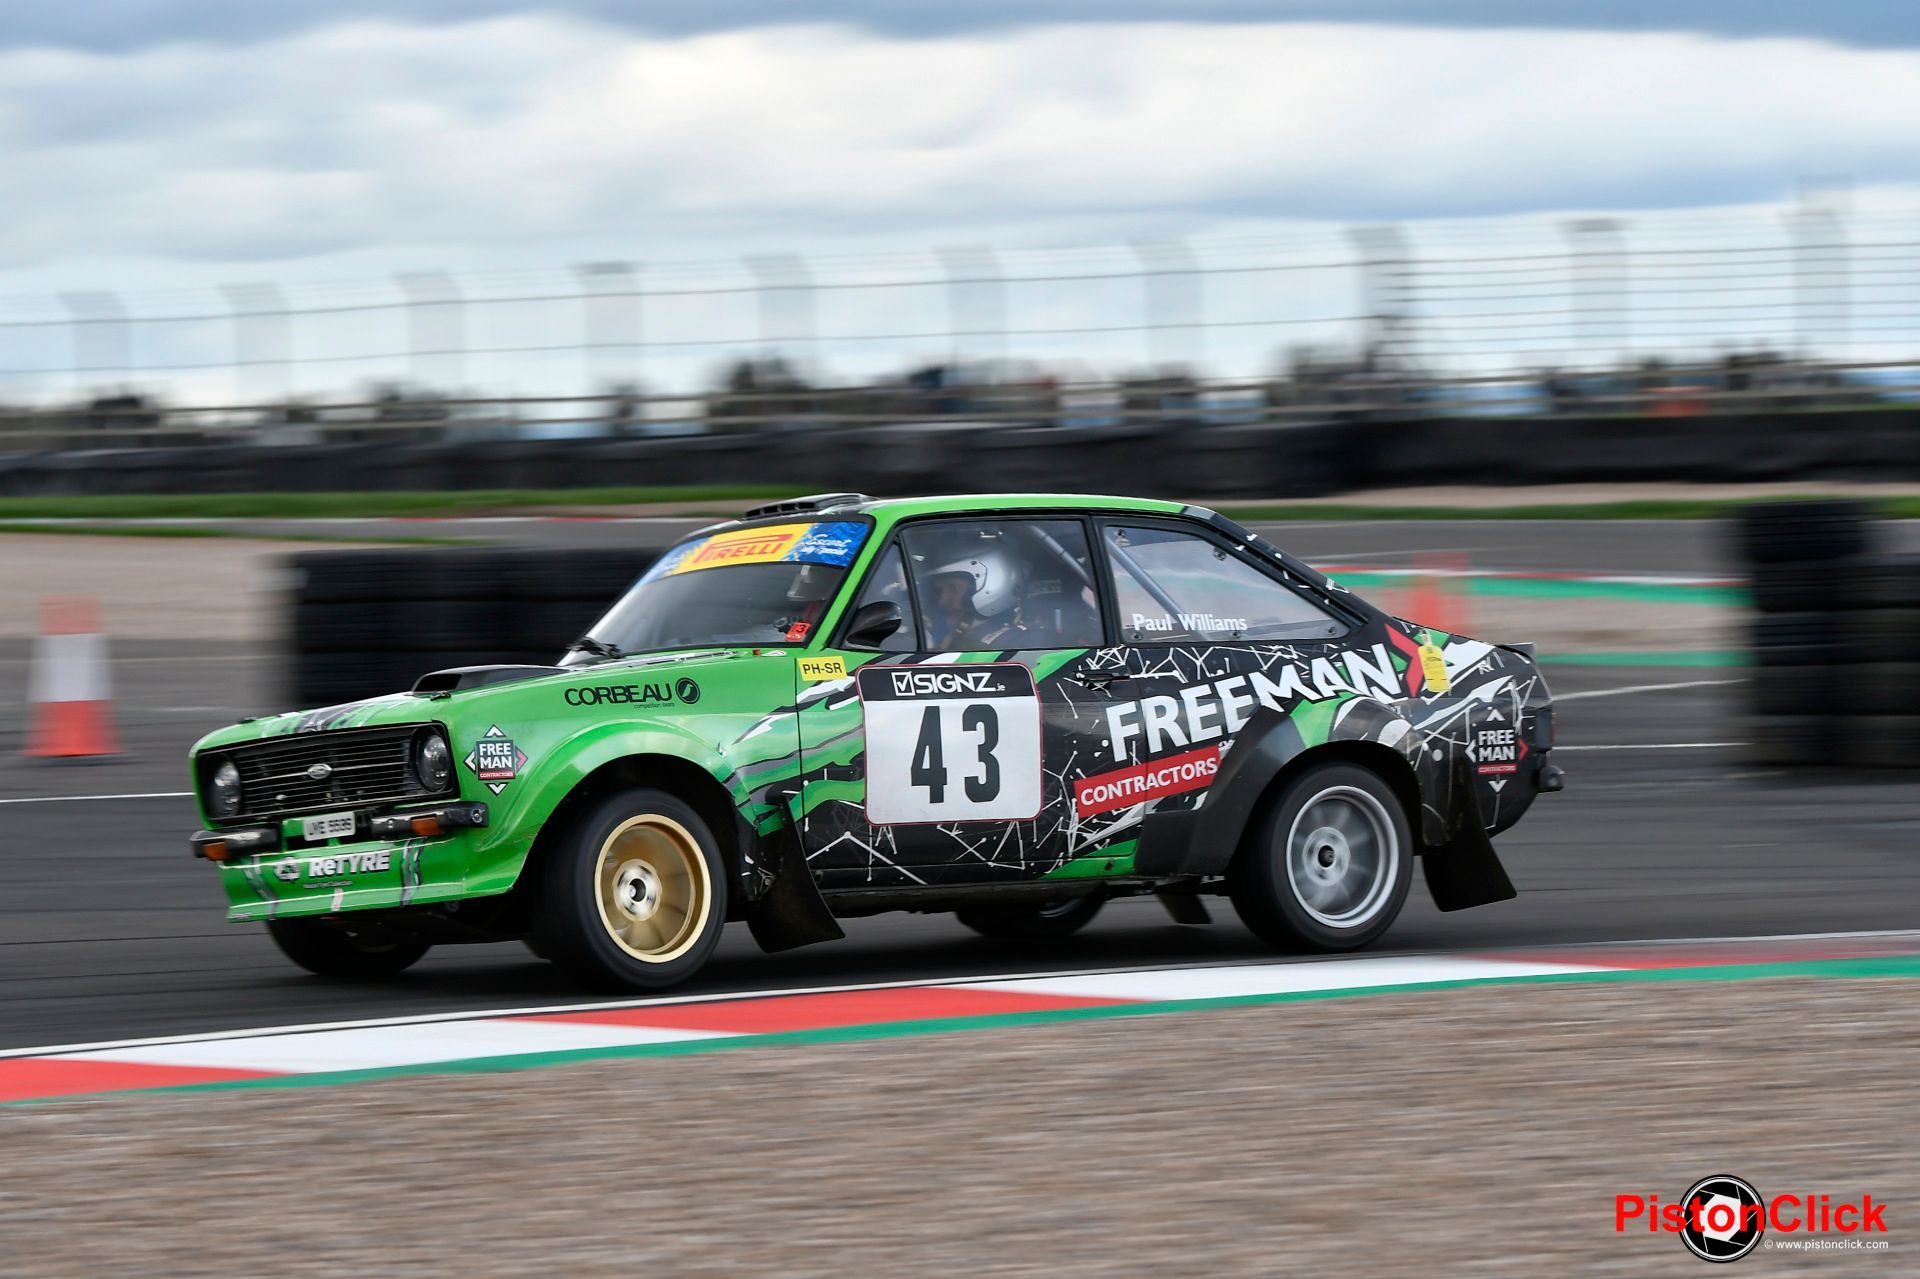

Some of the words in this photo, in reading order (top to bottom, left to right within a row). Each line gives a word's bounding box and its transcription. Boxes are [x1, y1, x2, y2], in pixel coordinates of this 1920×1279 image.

[693, 533, 794, 564] PIRELLI
[1131, 613, 1173, 631] Paul
[1177, 614, 1248, 631] Williams
[802, 662, 843, 675] PH-SR
[564, 683, 672, 706] CORBEAU
[1105, 643, 1401, 762] FREEMAN
[1478, 729, 1515, 746] FREE
[478, 742, 512, 756] FREE
[911, 703, 1000, 804] 43
[1479, 745, 1516, 762] MAN
[480, 756, 512, 769] MAN
[1080, 757, 1218, 807] CONTRACTORS
